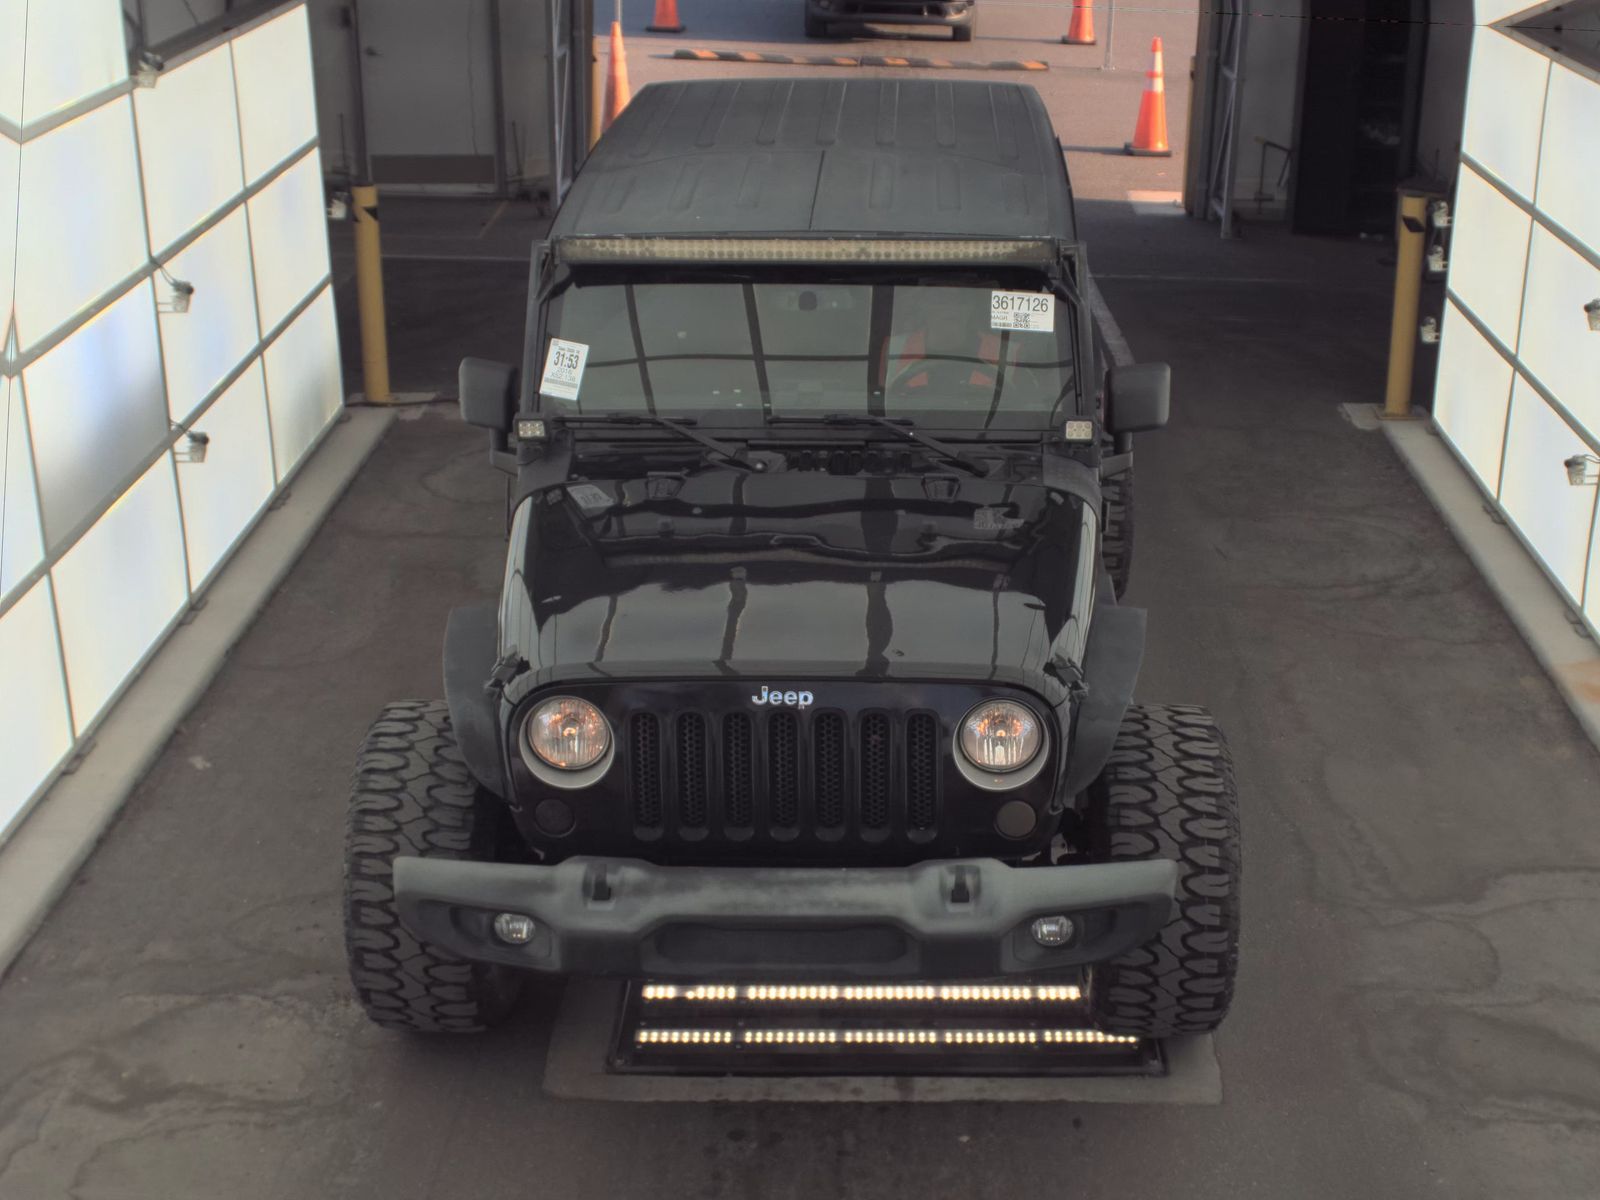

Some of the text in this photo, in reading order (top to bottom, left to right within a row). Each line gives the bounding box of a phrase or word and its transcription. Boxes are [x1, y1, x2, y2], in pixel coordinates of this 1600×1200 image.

[992, 294, 1049, 313] 3617126
[553, 351, 580, 370] 31:53
[751, 685, 814, 710] Jeep
